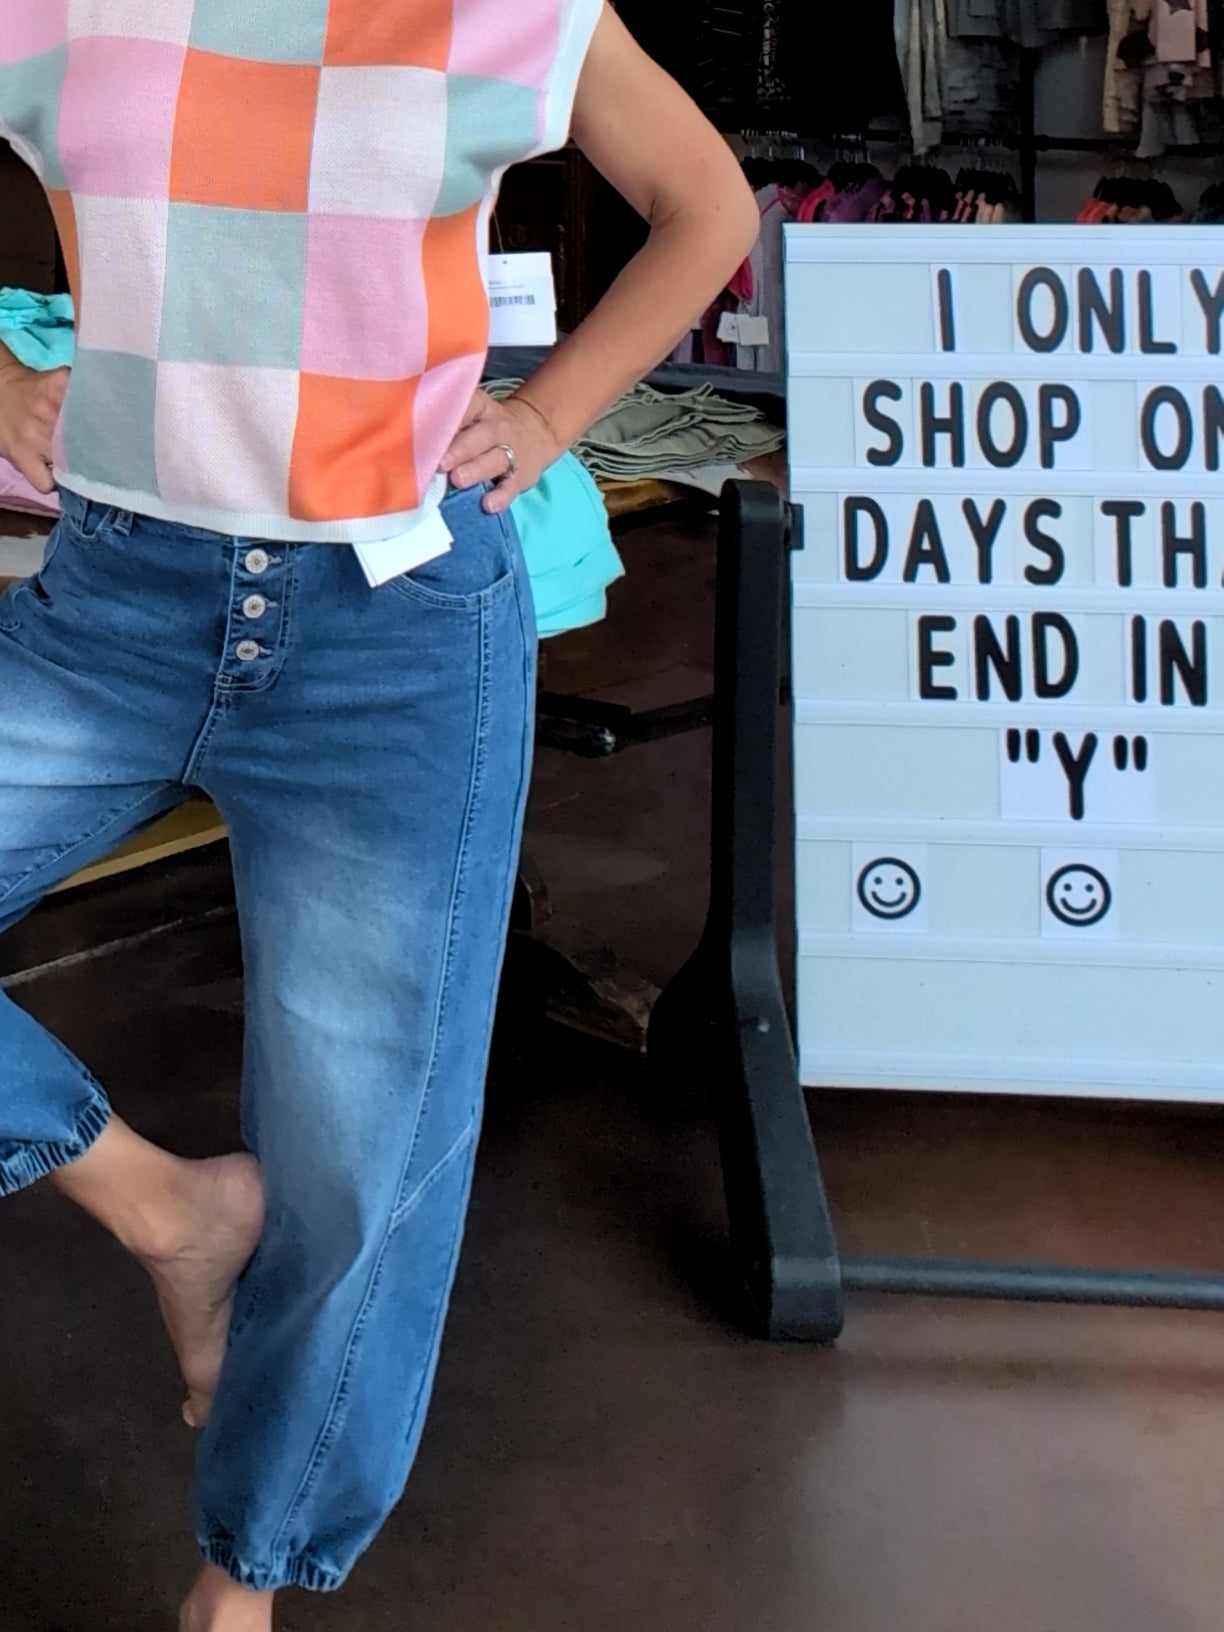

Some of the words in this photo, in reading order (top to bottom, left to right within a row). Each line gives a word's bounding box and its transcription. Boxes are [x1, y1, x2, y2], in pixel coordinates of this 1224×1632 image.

[937, 267, 956, 353] I
[1016, 266, 1224, 355] ONLY
[862, 379, 1082, 469] SHOP
[842, 495, 1066, 586] DAYS
[1100, 499, 1224, 589] TH
[917, 610, 1080, 702] END
[1131, 613, 1209, 707] IN
